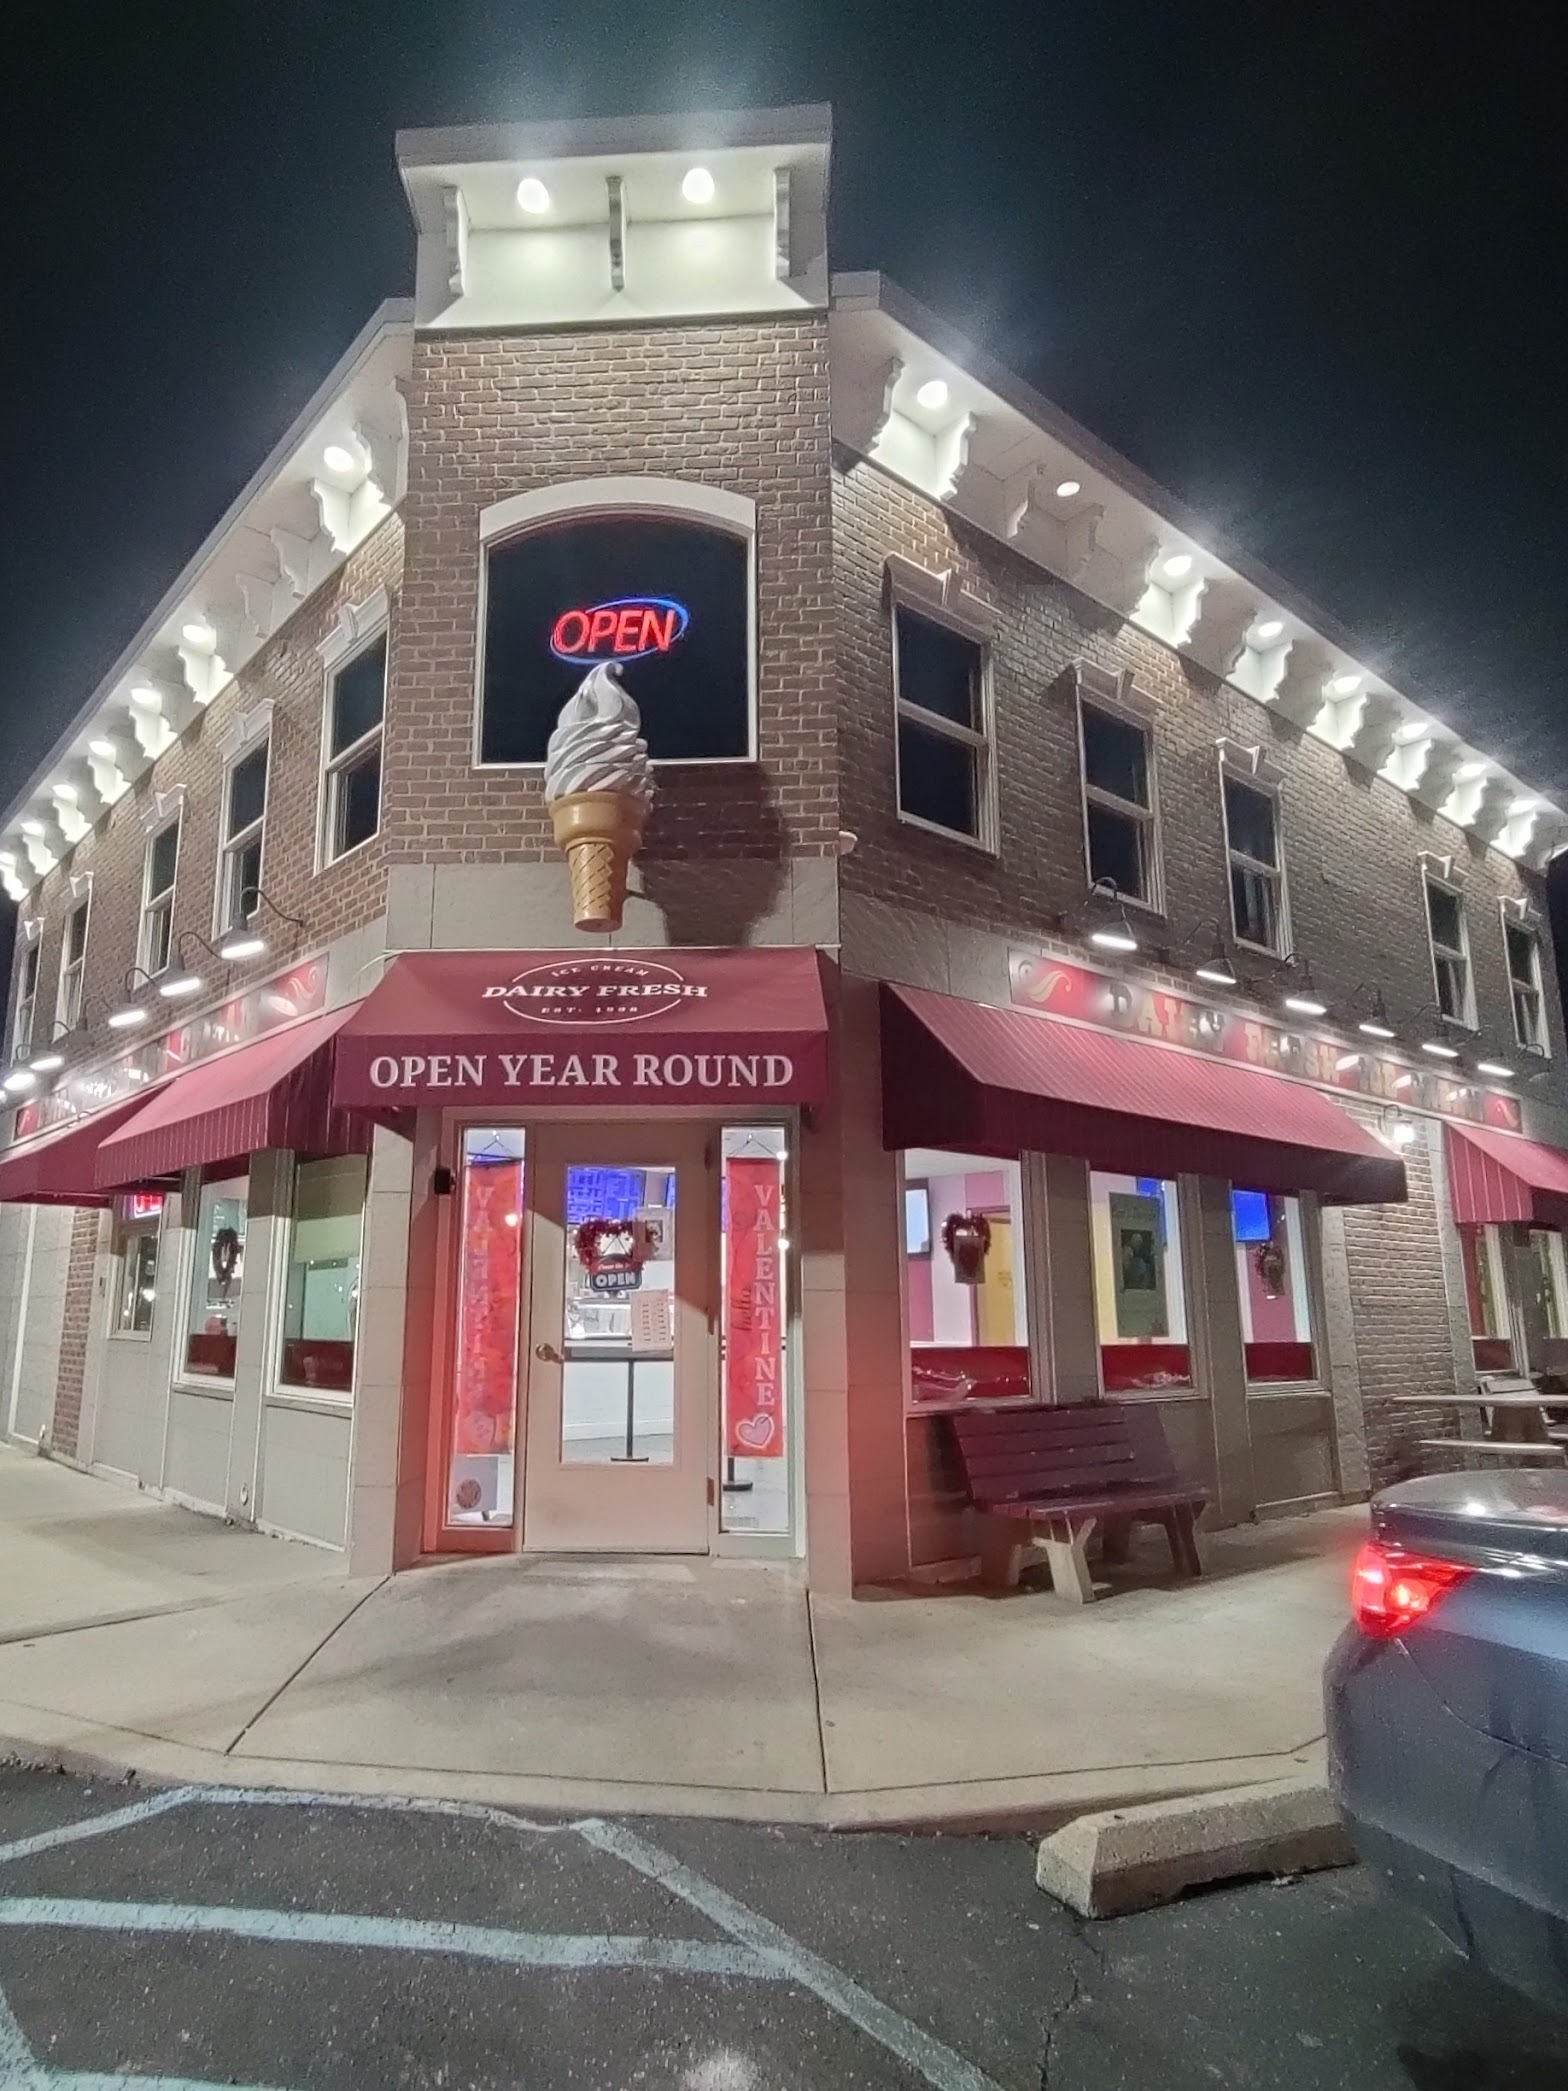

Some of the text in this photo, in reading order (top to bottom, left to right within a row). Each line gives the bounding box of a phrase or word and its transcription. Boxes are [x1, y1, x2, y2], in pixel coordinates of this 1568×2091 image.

[553, 609, 676, 653] OPEN
[551, 964, 650, 977] ICE CREAM
[481, 983, 708, 998] DAIRY FRESH
[369, 1054, 793, 1088] OPEN YEAR ROUND
[595, 1271, 636, 1287] OPEN
[753, 1185, 776, 1406] VALENTINE
